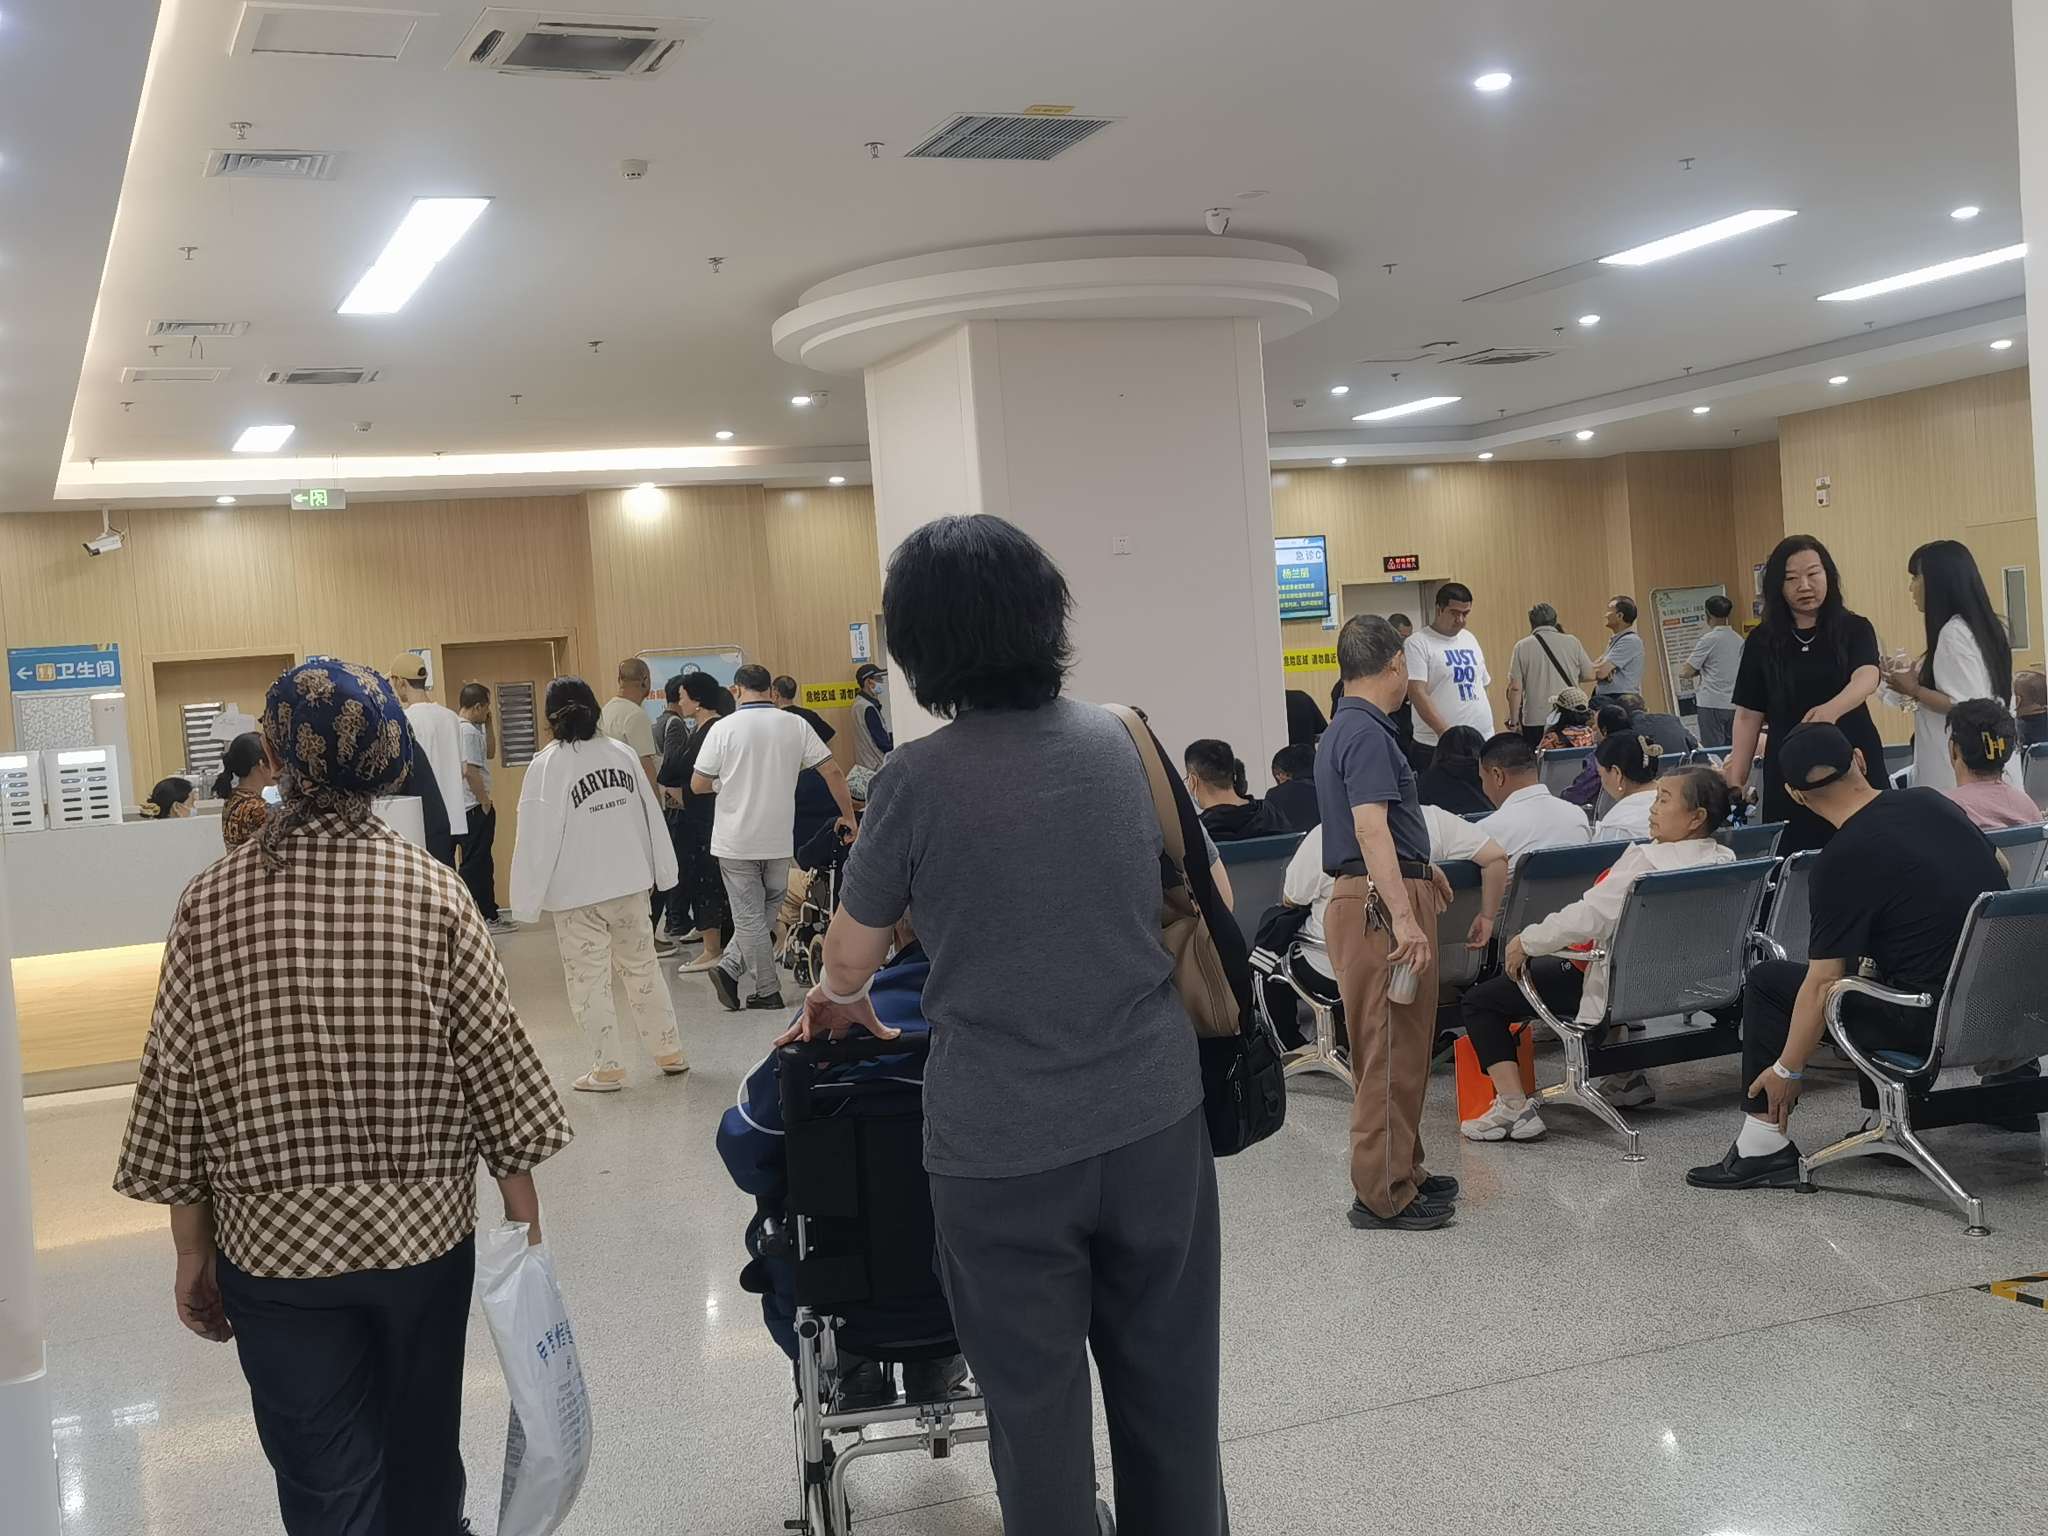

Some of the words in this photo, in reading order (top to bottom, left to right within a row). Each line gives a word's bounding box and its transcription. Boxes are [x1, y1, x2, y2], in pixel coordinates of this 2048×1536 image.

[1444, 649, 1477, 666] JUST
[56, 660, 115, 680] 卫生间
[1453, 666, 1475, 683] DO
[806, 690, 836, 702] 危险区域
[571, 768, 634, 809] HARVARD
[605, 801, 616, 809] AND
